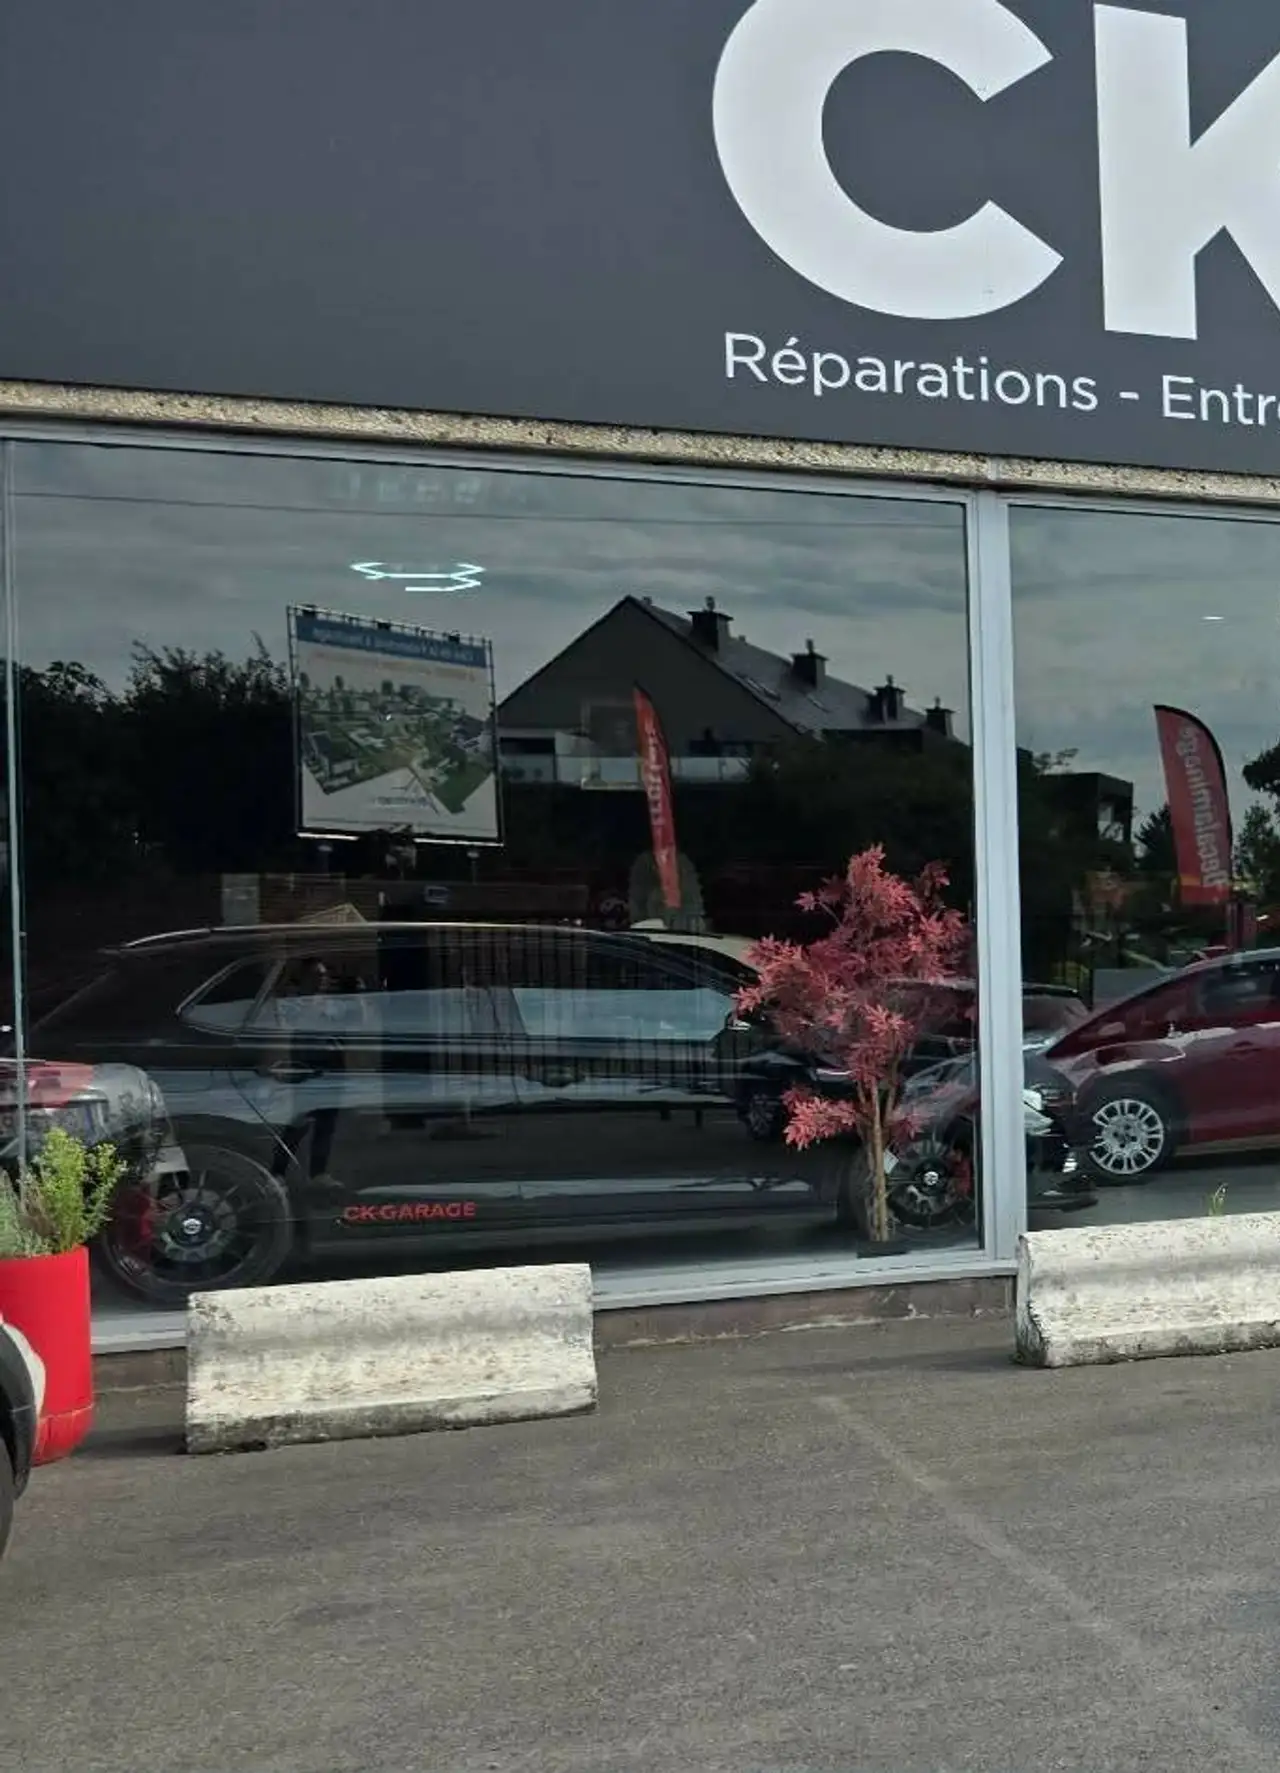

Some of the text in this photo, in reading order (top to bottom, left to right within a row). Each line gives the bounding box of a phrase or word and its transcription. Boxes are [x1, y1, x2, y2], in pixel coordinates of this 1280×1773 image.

[725, 332, 1098, 411] Réparations
[344, 1201, 477, 1221] CK GARAGE
